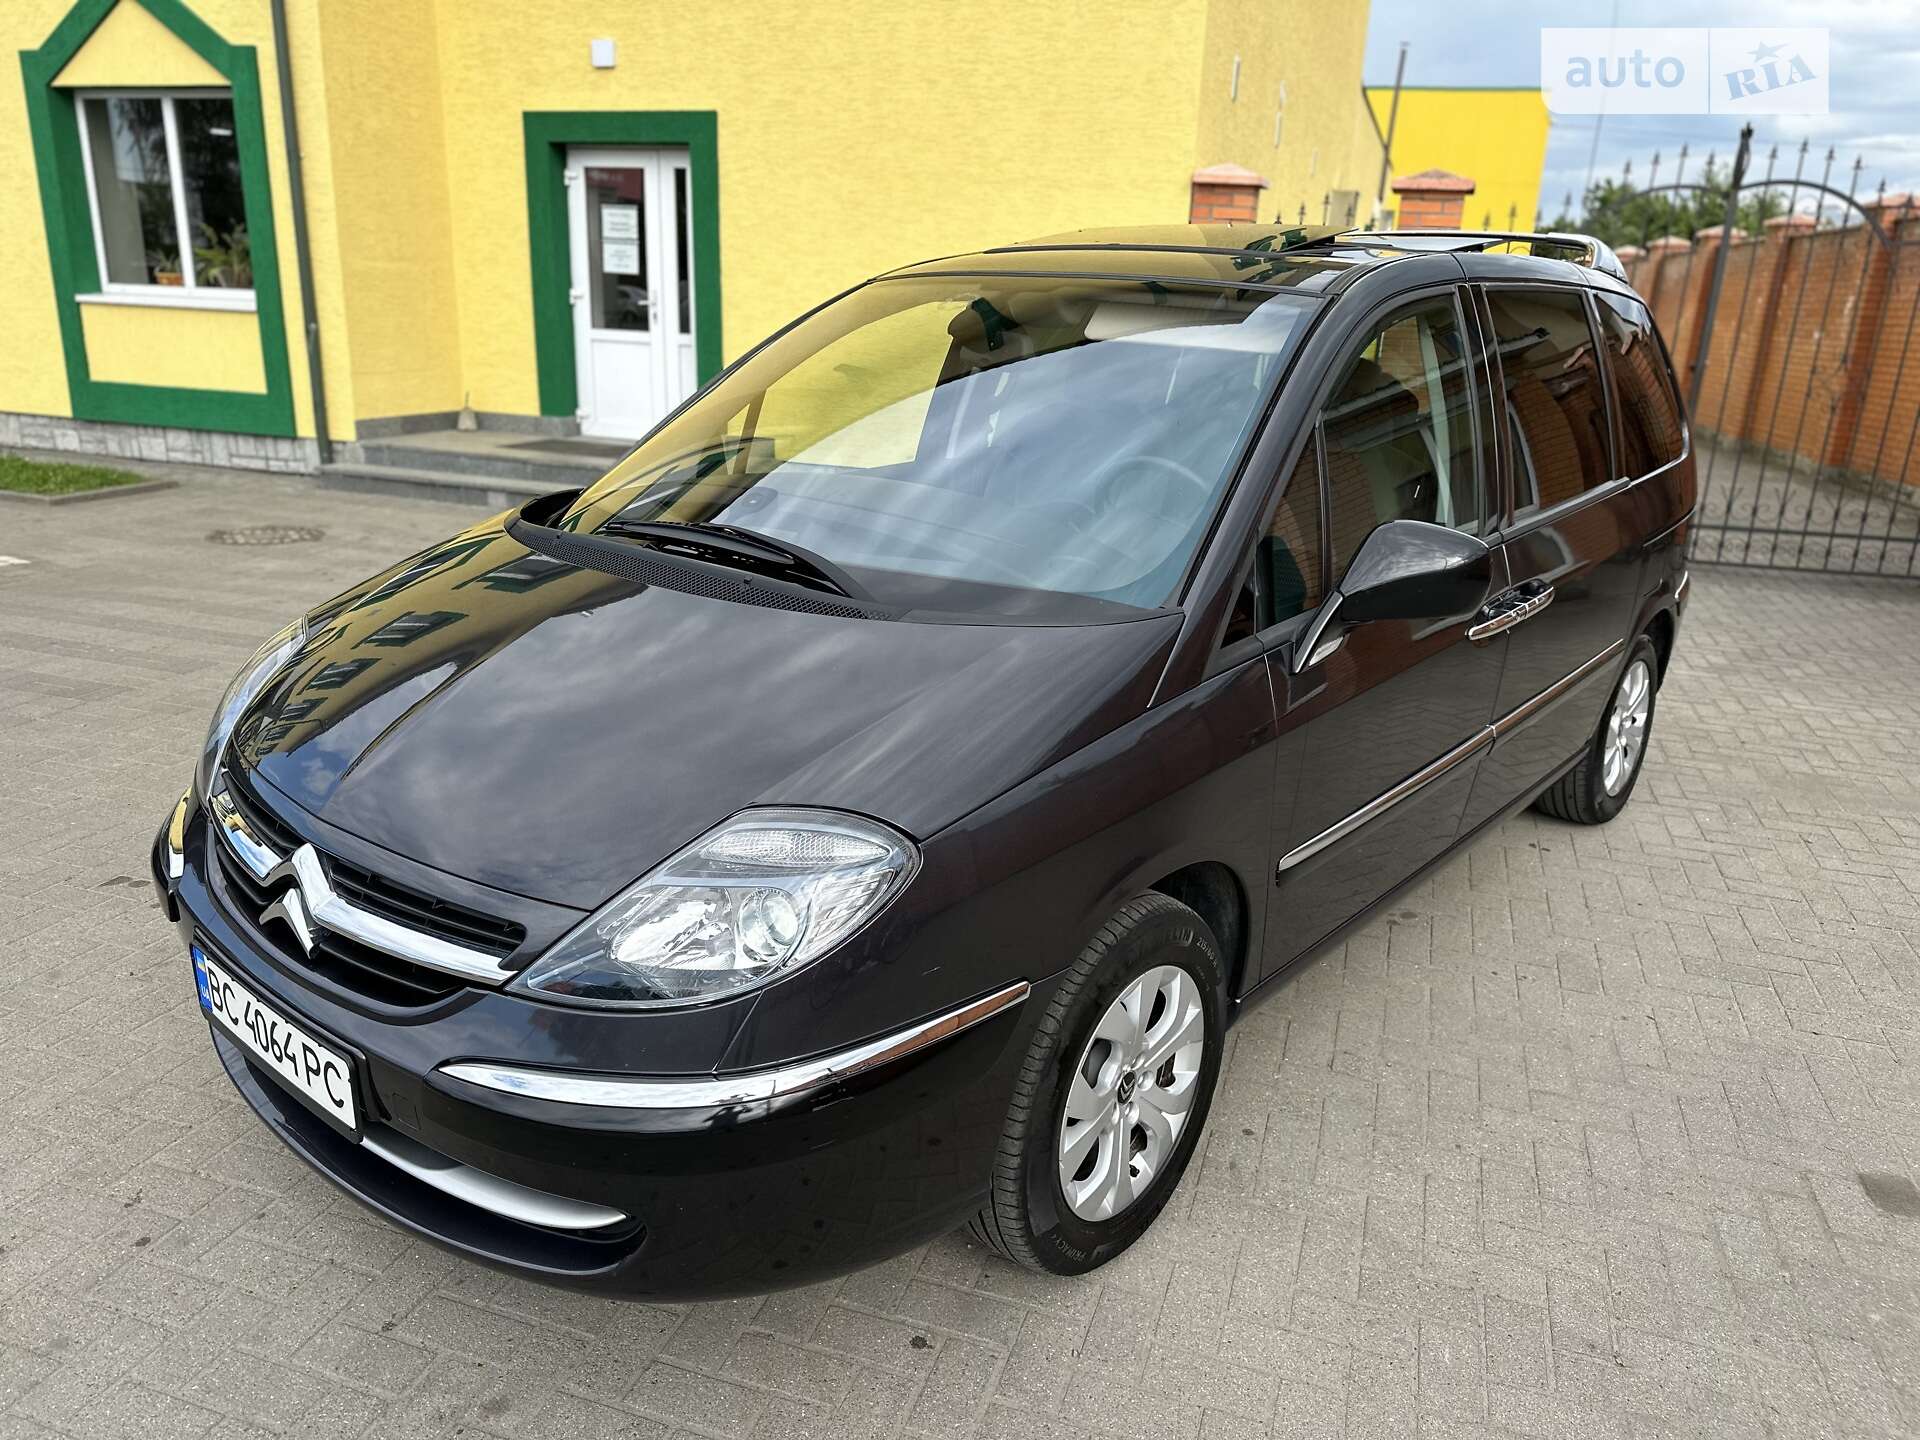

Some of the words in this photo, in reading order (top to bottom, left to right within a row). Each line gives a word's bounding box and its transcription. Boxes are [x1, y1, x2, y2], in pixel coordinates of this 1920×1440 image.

[207, 968, 239, 1026] BC
[243, 1000, 299, 1077] 4064
[302, 1042, 345, 1109] PC
